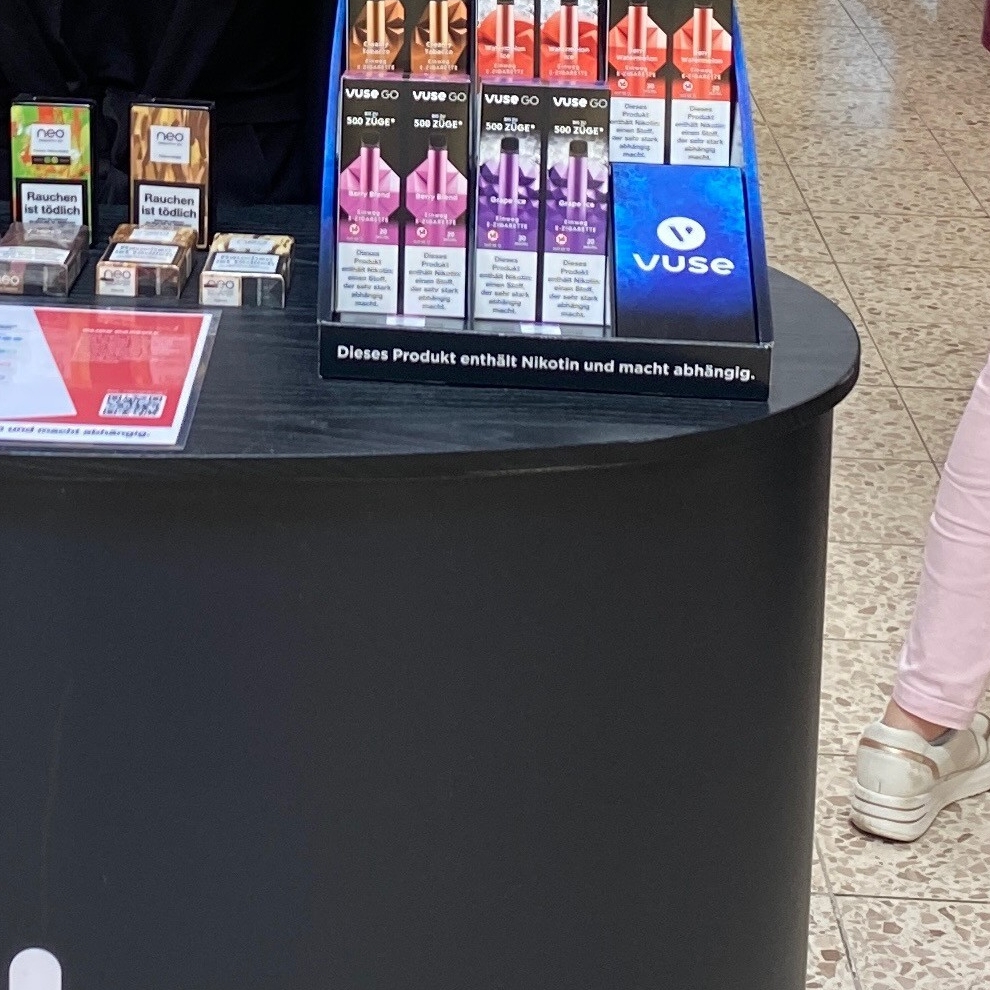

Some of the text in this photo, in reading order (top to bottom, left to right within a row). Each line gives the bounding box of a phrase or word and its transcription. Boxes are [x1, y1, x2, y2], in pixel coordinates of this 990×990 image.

[380, 89, 399, 100] GO
[448, 92, 466, 102] GO
[520, 95, 540, 106] GO
[589, 98, 608, 108] GO
[346, 116, 364, 126] 500
[414, 119, 431, 128] 500
[486, 122, 502, 131] 500
[37, 128, 65, 138] neo
[554, 126, 572, 134] 500
[156, 131, 184, 142] neo
[27, 192, 78, 203] Rauchen
[144, 192, 195, 206] Rauchen
[24, 205, 80, 216] ist tödlich
[142, 206, 197, 219] ist tödlich
[337, 344, 756, 383] Dieses Produkt enthält Nikotin und macht abhängig.
